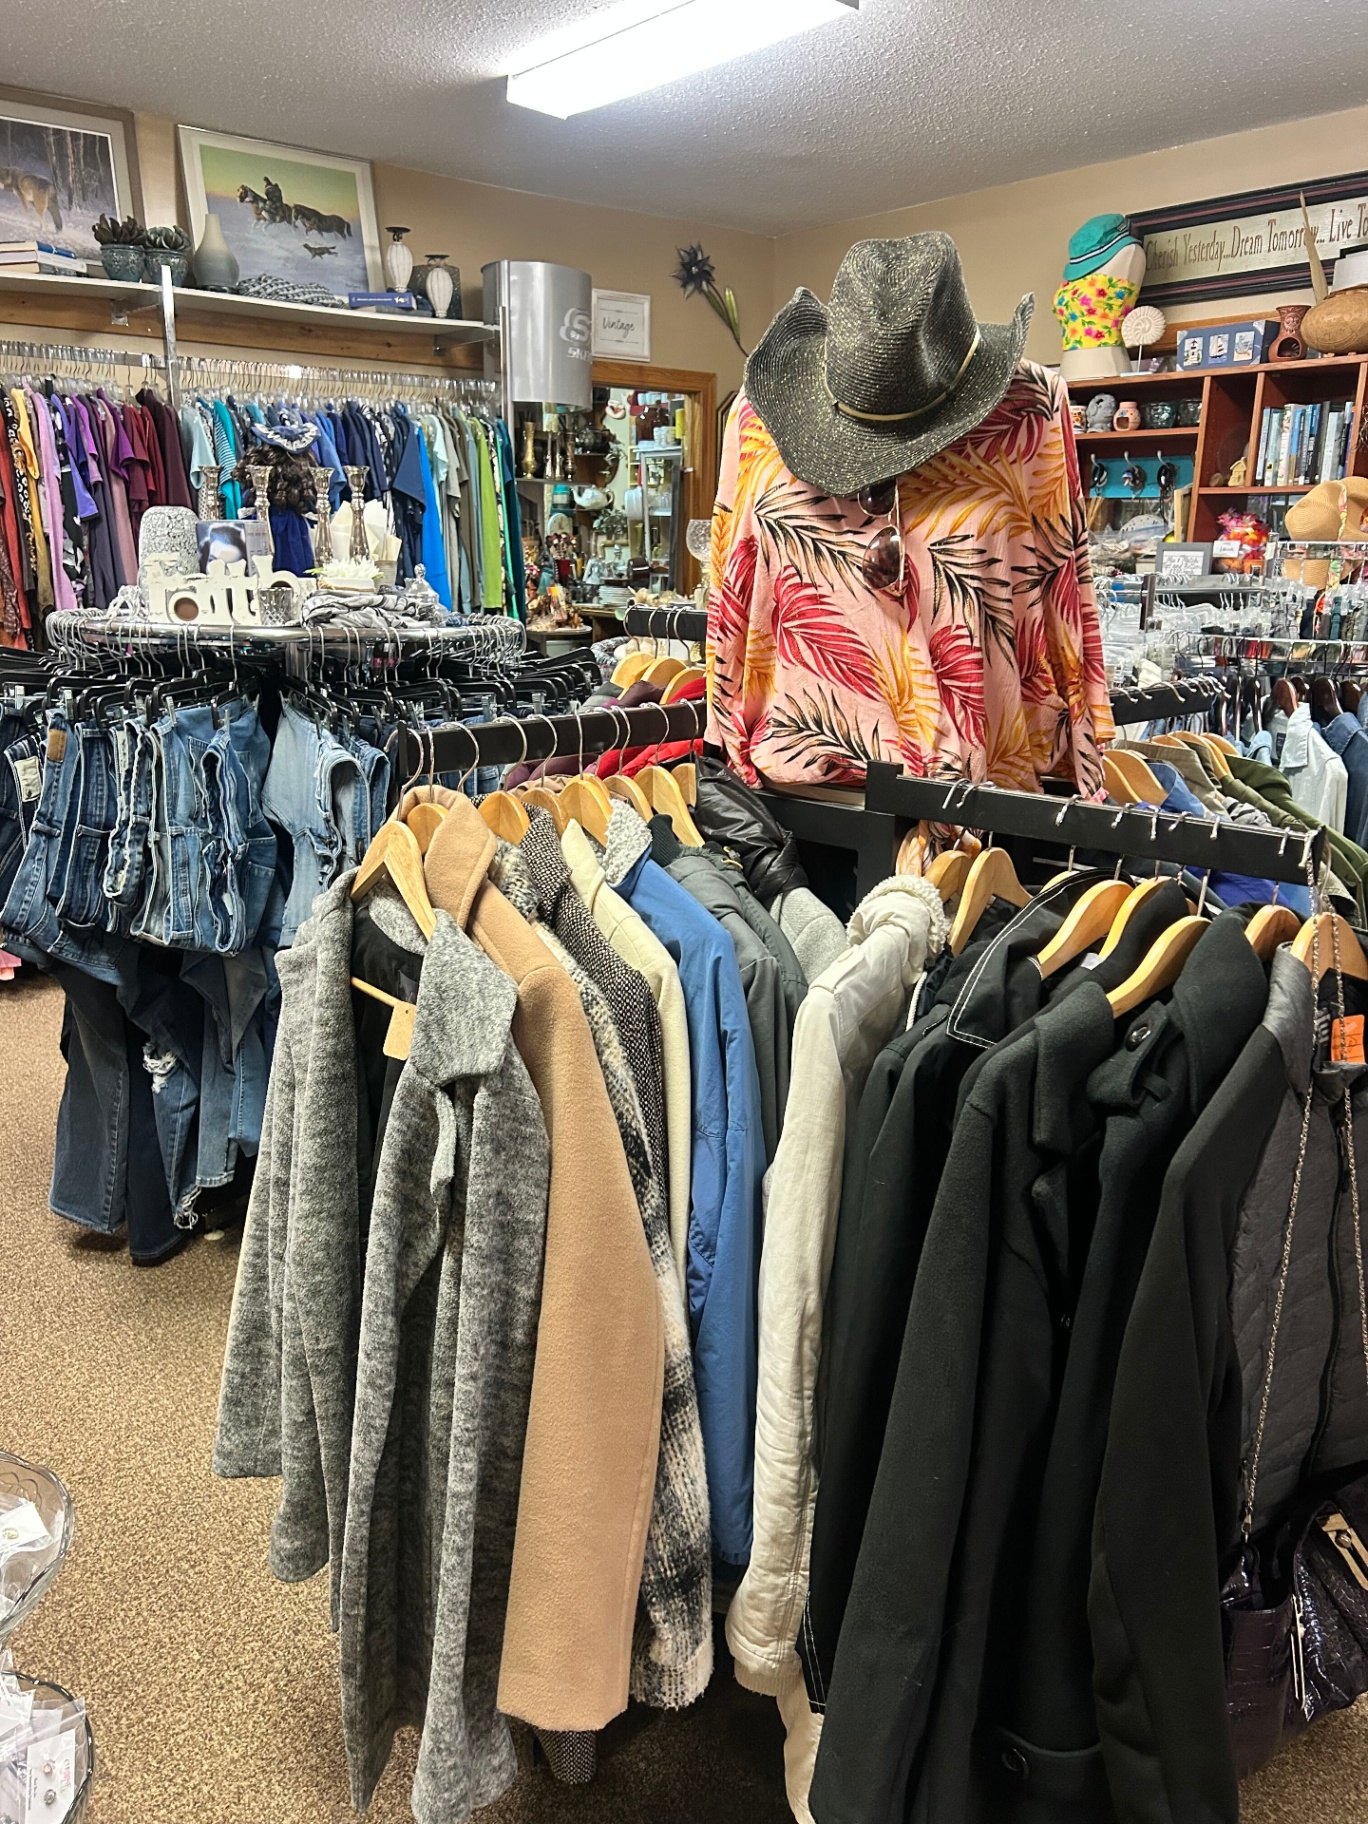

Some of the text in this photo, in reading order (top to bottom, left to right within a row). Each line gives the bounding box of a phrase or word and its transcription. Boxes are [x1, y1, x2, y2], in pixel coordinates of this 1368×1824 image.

[1146, 236, 1178, 270] Cherish
[1329, 208, 1353, 242] Live
[602, 317, 635, 338] Vintage
